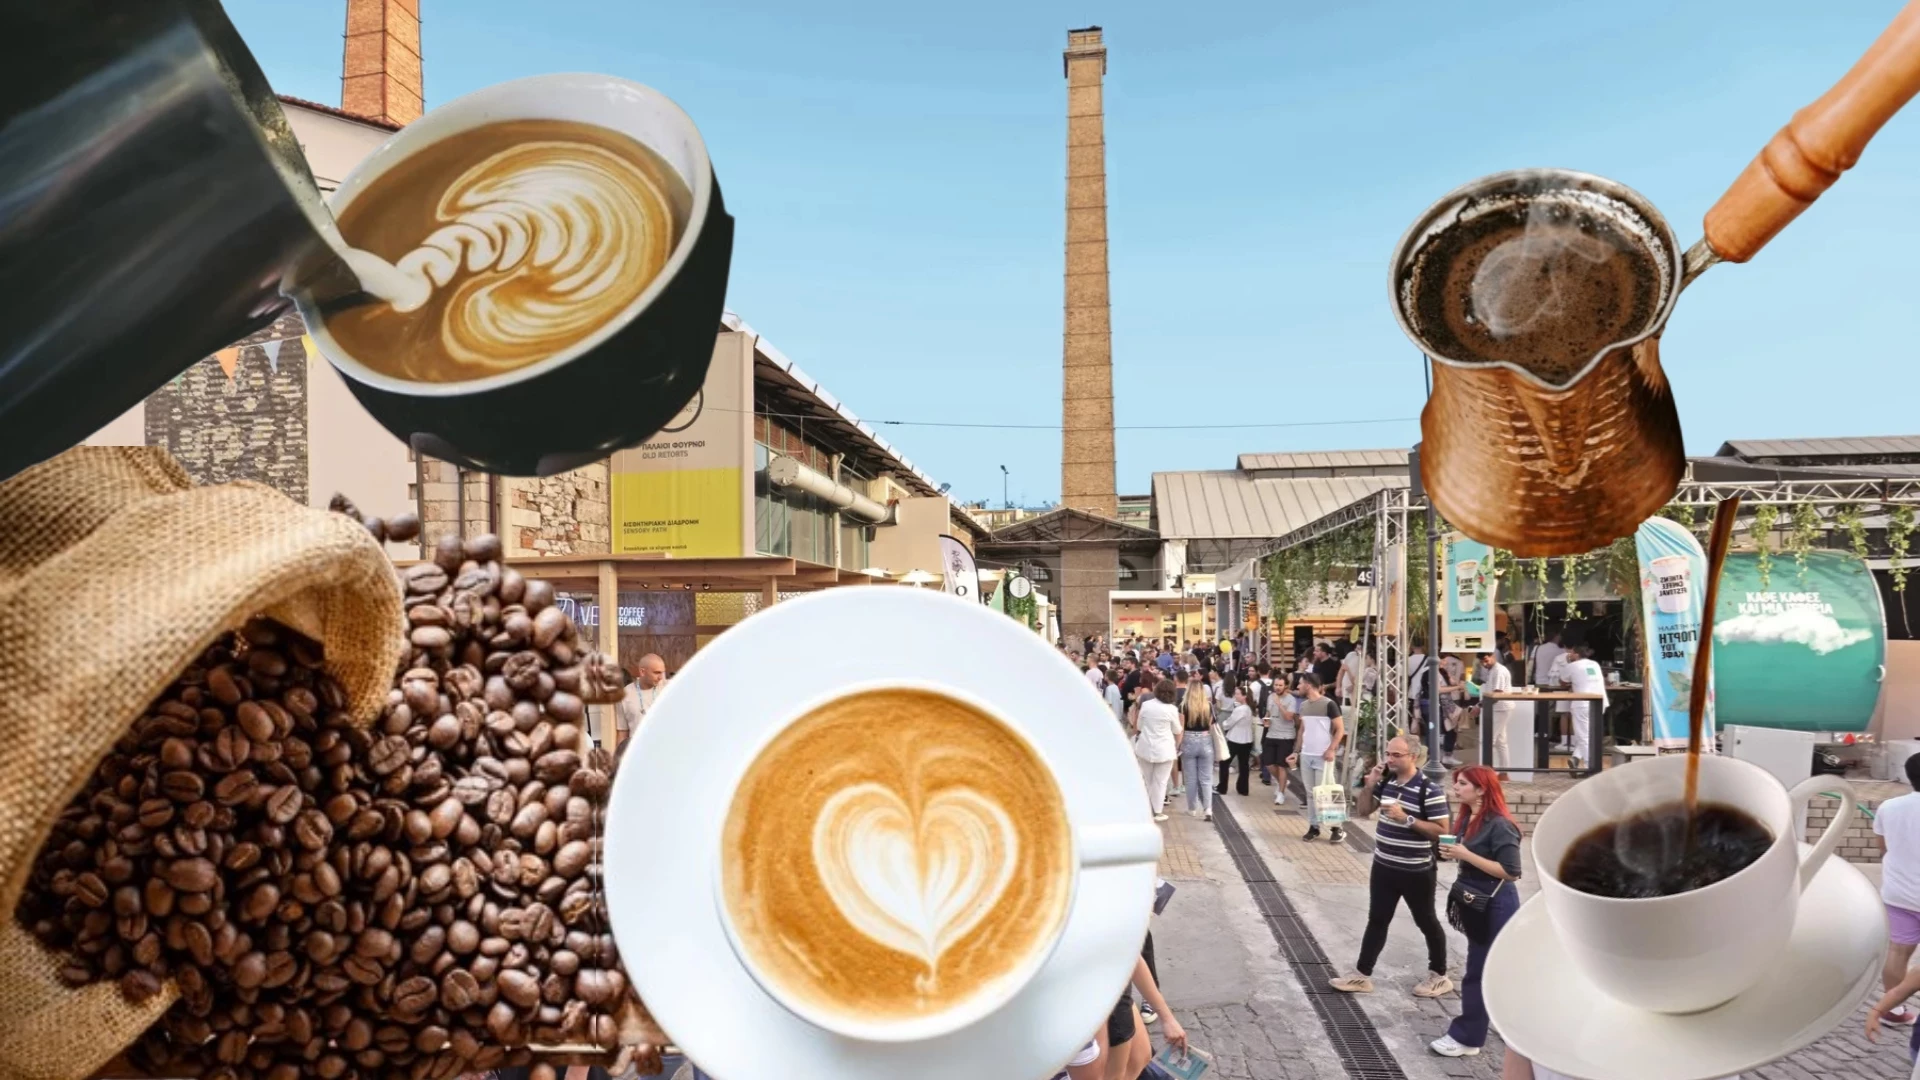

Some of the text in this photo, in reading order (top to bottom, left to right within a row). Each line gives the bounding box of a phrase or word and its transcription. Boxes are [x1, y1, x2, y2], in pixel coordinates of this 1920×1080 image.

[672, 440, 705, 448] ΦΟΥΡΝΟΙ
[1746, 592, 1820, 602] ΚΑΘΕ ΚΑΦΕΣ
[619, 607, 644, 617] COFFEE
[1738, 603, 1760, 614] ΚΑΙ
[1761, 603, 1784, 614] ΜΙΑ
[619, 617, 642, 626] BEANS
